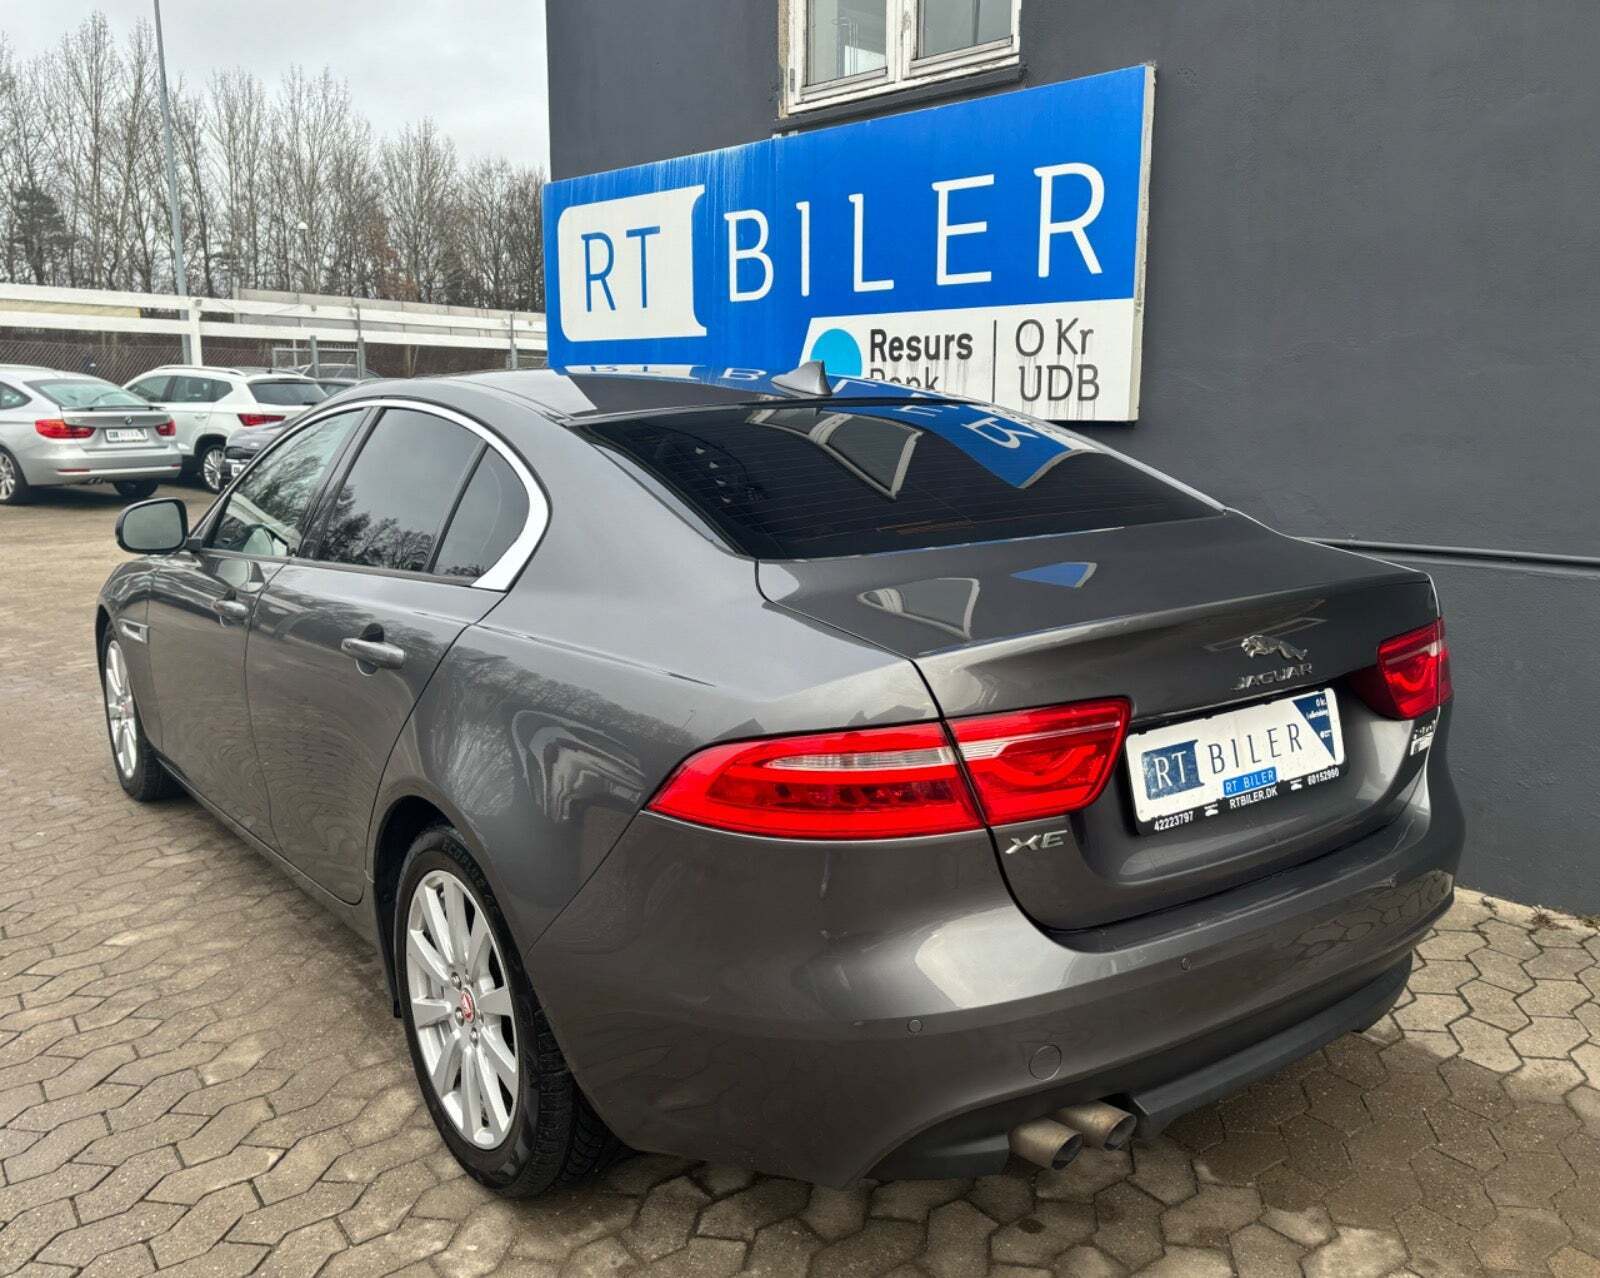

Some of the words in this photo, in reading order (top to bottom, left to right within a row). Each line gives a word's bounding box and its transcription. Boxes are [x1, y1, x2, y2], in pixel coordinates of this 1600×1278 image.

[580, 225, 661, 314] RT
[723, 161, 1106, 303] BILER
[869, 328, 974, 362] Resurs
[1055, 317, 1095, 356] Kr
[1018, 363, 1100, 402] UDB
[1230, 663, 1313, 690] JAGUAR
[1154, 750, 1187, 789] RT
[1207, 722, 1303, 775] BILER
[1225, 780, 1238, 793] RT
[1243, 770, 1275, 791] BILER
[1229, 786, 1278, 810] RTBILER.DK
[1154, 811, 1195, 832] 42223797
[1005, 829, 1068, 854] XE
